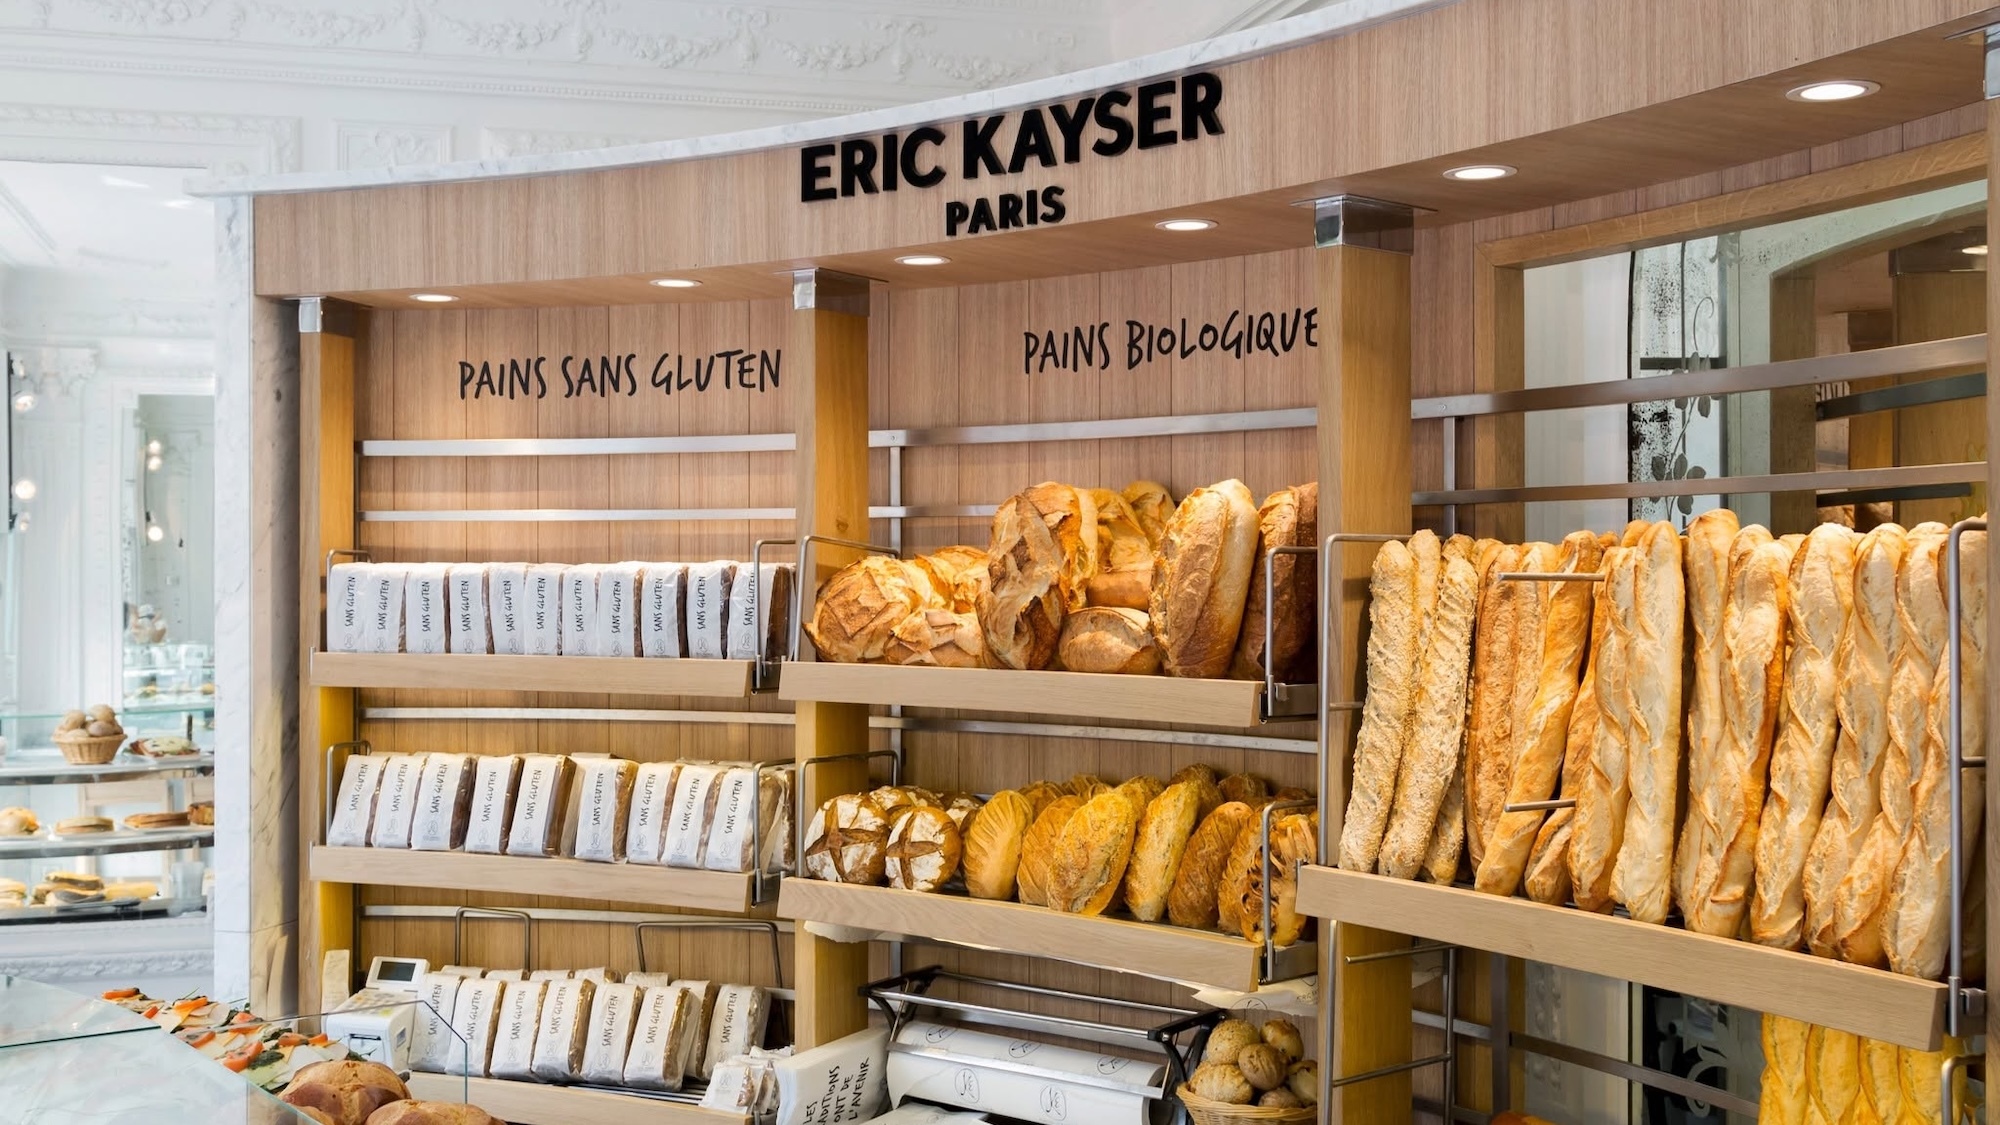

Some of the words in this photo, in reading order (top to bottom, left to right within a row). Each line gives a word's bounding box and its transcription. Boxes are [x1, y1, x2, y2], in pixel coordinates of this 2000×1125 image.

[801, 127, 946, 202] ERIC
[962, 72, 1225, 179] KAYSER
[946, 185, 1066, 236] PARIS
[1024, 322, 1110, 374] PAINS
[458, 356, 547, 400] PAINS
[561, 354, 636, 398] SANS
[651, 349, 781, 395] GLUTEN
[346, 577, 356, 607] GLUTEN
[379, 580, 389, 610] GLUTEN
[421, 581, 431, 612] GLUTEN
[461, 580, 470, 611] GLUTEN
[503, 580, 514, 611] GLUTEN
[537, 577, 546, 609] GLUTEN
[574, 579, 583, 611] GLUTEN
[612, 581, 622, 613] GLUTEN
[654, 578, 663, 611] GLUTEN
[696, 576, 706, 608] GLUTEN
[345, 609, 355, 627] SANS
[377, 612, 388, 630] SANS
[422, 614, 431, 632] SANS
[462, 614, 471, 632] SANS
[505, 614, 515, 632] SANS
[537, 611, 545, 630] SANS
[576, 613, 584, 632] SANS
[611, 615, 620, 634] SANS
[653, 613, 663, 632] SANS
[697, 611, 706, 630] SANS
[743, 607, 754, 626] SANS
[354, 763, 368, 792] GLUTEN
[395, 763, 408, 793] GLUTEN
[434, 763, 448, 793] GLUTEN
[485, 771, 497, 802] GLUTEN
[594, 772, 604, 805] GLUTEN
[643, 773, 656, 806] GLUTEN
[349, 793, 360, 811] SANS
[391, 793, 400, 812] SANS
[430, 793, 441, 814] SANS
[524, 801, 536, 820] SANS
[530, 769, 542, 800] GLUTEN
[681, 812, 691, 832] SANS
[687, 778, 700, 810] GLUTEN
[729, 779, 743, 813] GLUTEN
[481, 803, 492, 822] SANS
[592, 806, 601, 826] SANS
[639, 807, 649, 827] SANS
[724, 815, 736, 834] SANS
[469, 990, 482, 1020] GLUTEN
[514, 990, 526, 1020] GLUTEN
[554, 986, 567, 1015] GLUTEN
[650, 994, 664, 1025] GLUTEN
[724, 992, 737, 1025] GLUTEN
[428, 1017, 439, 1035] SANS
[465, 1022, 476, 1040] SANS
[510, 1022, 521, 1040] SANS
[550, 1016, 561, 1035] SANS
[602, 1027, 613, 1047] SANS
[608, 995, 618, 1027] GLUTEN
[645, 1025, 657, 1044] SANS
[721, 1025, 732, 1043] SANS
[818, 1065, 840, 1125] ADITIONS
[834, 1096, 846, 1123] ONT
[841, 1075, 853, 1091] DE
[849, 1057, 869, 1120] L'AVENIR
[803, 1101, 818, 1125] LES
